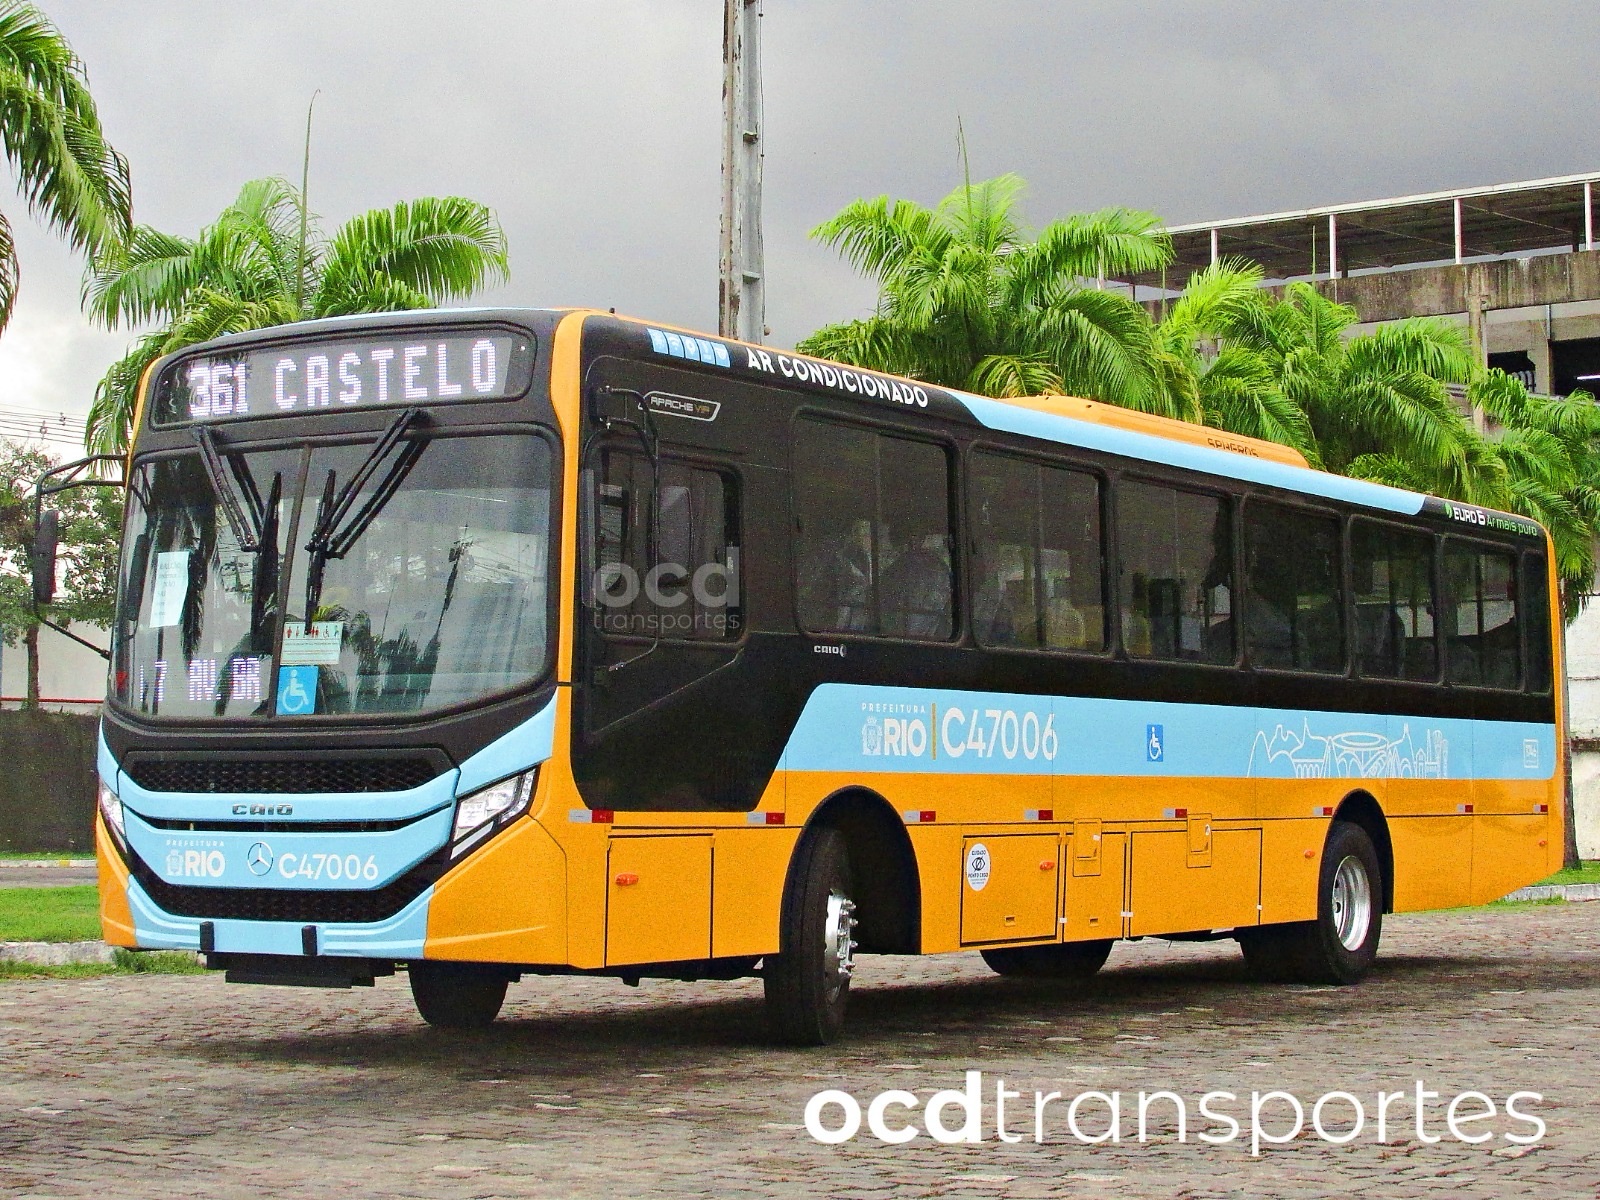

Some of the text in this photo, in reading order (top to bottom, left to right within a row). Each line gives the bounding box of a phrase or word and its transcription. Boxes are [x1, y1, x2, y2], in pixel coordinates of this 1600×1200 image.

[190, 338, 496, 416] 361 CASTELO
[747, 347, 929, 408] AR CONDICIONADO
[650, 396, 694, 412] APACHE
[861, 702, 926, 714] PREFEITURA
[883, 707, 1059, 760] RIO C47006
[232, 803, 293, 816] CAIO
[166, 839, 225, 847] PREFEITURA
[185, 850, 379, 881] RIO C47006
